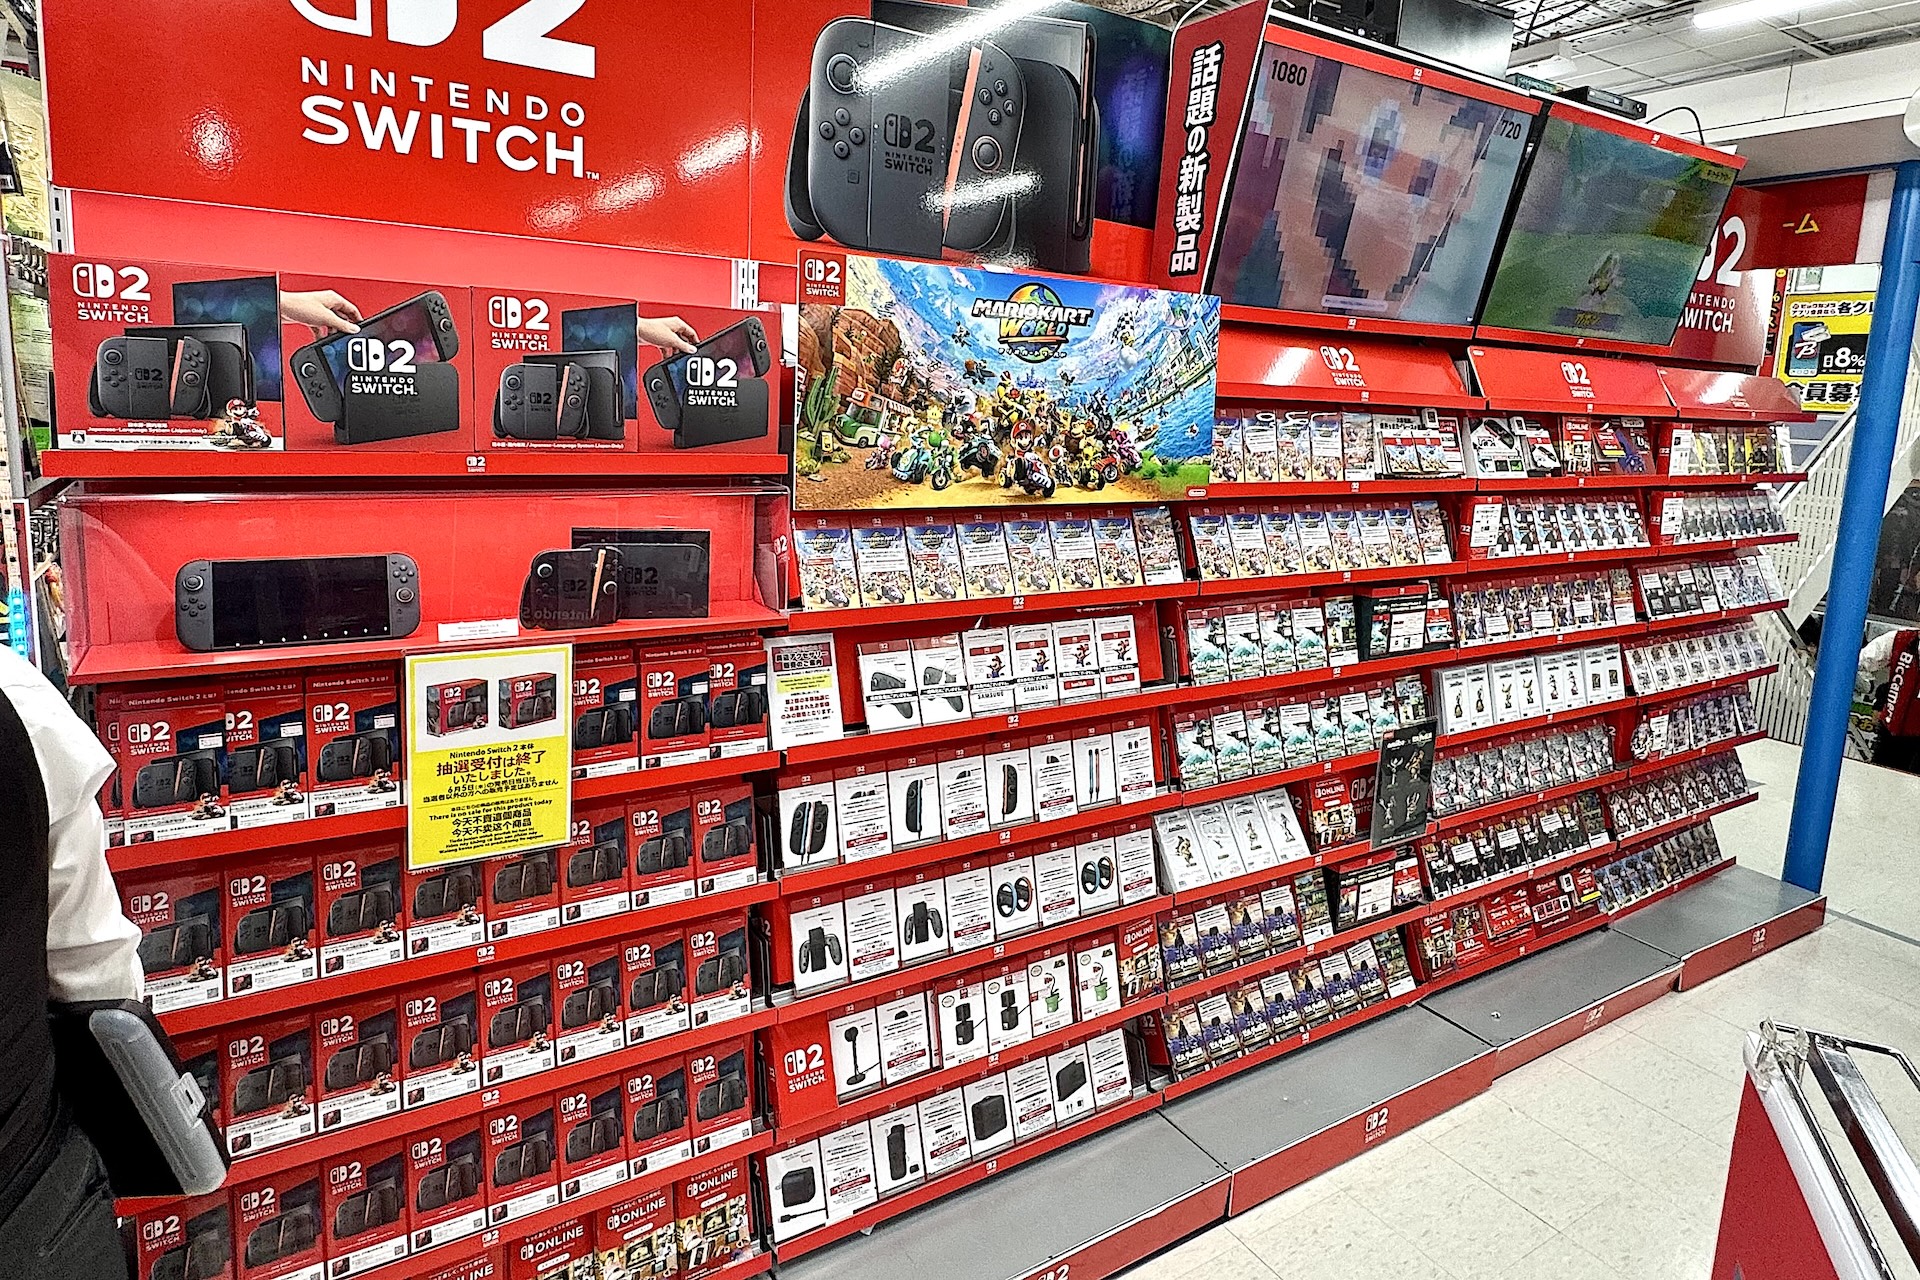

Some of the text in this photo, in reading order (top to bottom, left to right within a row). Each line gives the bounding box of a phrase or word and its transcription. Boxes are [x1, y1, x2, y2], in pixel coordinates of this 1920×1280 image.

[1271, 59, 1308, 86] 1080
[301, 56, 585, 128] NINTENDO
[301, 95, 584, 178] SWITCH
[915, 119, 935, 154] 2
[1500, 120, 1521, 140] 720
[885, 152, 934, 164] NINTENDO
[1170, 43, 1222, 273] 話題の新製品
[885, 158, 933, 176] SWITCH
[1716, 216, 1746, 288] 2
[826, 262, 841, 283] 2
[118, 265, 151, 301] 2
[806, 288, 840, 298] SWITCH
[1690, 292, 1736, 311] NTENDO
[77, 302, 149, 312] NINTENDO
[525, 298, 550, 331] 2
[77, 310, 150, 323] SWITCH
[491, 332, 547, 341] NINTENDO
[999, 318, 1068, 338] WORLD
[491, 339, 549, 352] SWITCH
[388, 339, 417, 374] 2
[1342, 351, 1361, 372] 2
[351, 375, 414, 384] NINTENDO
[716, 358, 738, 388] 2
[1576, 366, 1591, 385] 2
[351, 382, 416, 396] SWITCH
[1334, 377, 1367, 387] SWITCH
[688, 395, 736, 407] SWITCH
[662, 671, 675, 686] 2
[722, 662, 734, 678] 2
[313, 679, 344, 688] Nintendo
[588, 678, 601, 695] 2
[1023, 684, 1049, 693] SAMSUNG
[129, 698, 165, 706] Nintendo
[237, 710, 253, 730] 2
[334, 702, 350, 721] 2
[154, 721, 171, 741] 2
[315, 725, 350, 735] SWITCH
[130, 745, 170, 756] SWITCH
[450, 748, 486, 759] Nintendo
[487, 744, 512, 755] Switch
[436, 750, 547, 776] 抽選受付は終了
[453, 767, 532, 785] いたしました。
[1321, 784, 1346, 796] ONLINE
[507, 801, 533, 811] product
[534, 799, 553, 807] today
[709, 799, 722, 814] 2
[645, 810, 659, 826] 2
[577, 820, 591, 837] 2
[343, 860, 357, 878] 2
[252, 875, 267, 893] 2
[325, 880, 356, 891] SWITCH
[154, 891, 169, 910] 2
[232, 896, 266, 908] SWITCH
[704, 931, 716, 946] 2
[1131, 924, 1154, 941] ONLINE
[640, 944, 652, 959] 2
[573, 961, 585, 976] 2
[501, 978, 514, 994] 2
[424, 997, 437, 1013] 2
[340, 1016, 355, 1032] 2
[249, 1035, 265, 1053] 2
[704, 1055, 716, 1070] 2
[804, 1044, 825, 1070] 2
[641, 1074, 654, 1089] 2
[789, 1075, 826, 1094] SWITCH
[575, 1093, 588, 1109] 2
[506, 1115, 518, 1130] 2
[1378, 1107, 1389, 1127] 2
[428, 1138, 443, 1153] 2
[348, 1162, 363, 1179] 2
[698, 1167, 739, 1191] ONLINE
[261, 1187, 276, 1205] 2
[620, 1197, 667, 1224] ONLINE
[164, 1215, 181, 1233] 2
[535, 1227, 584, 1252] ONLINE
